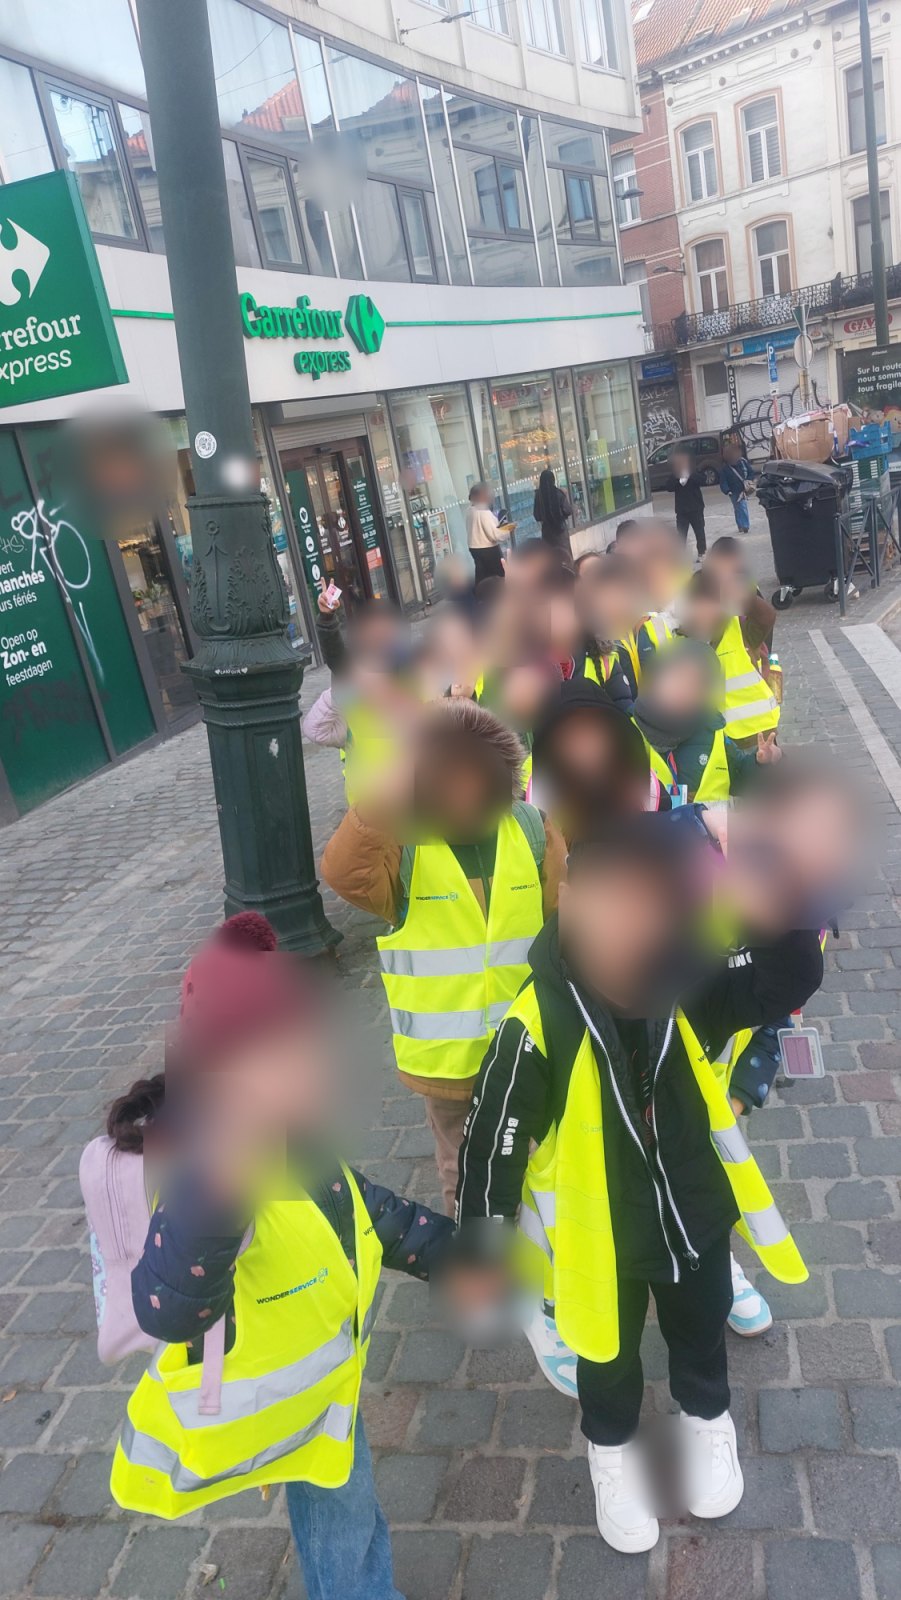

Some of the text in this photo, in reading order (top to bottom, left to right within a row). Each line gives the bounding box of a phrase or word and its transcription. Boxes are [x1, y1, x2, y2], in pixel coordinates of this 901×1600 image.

[240, 292, 344, 339] Carrefour
[0, 314, 81, 351] refour
[294, 350, 351, 381] express
[857, 367, 870, 375] Sur
[872, 365, 880, 373] la
[857, 375, 876, 383] nous
[858, 385, 874, 393] tous
[12, 589, 37, 608] fériés
[1, 628, 38, 650] Open op
[0, 641, 47, 669] Zon- en
[6, 659, 53, 687] feestdagen
